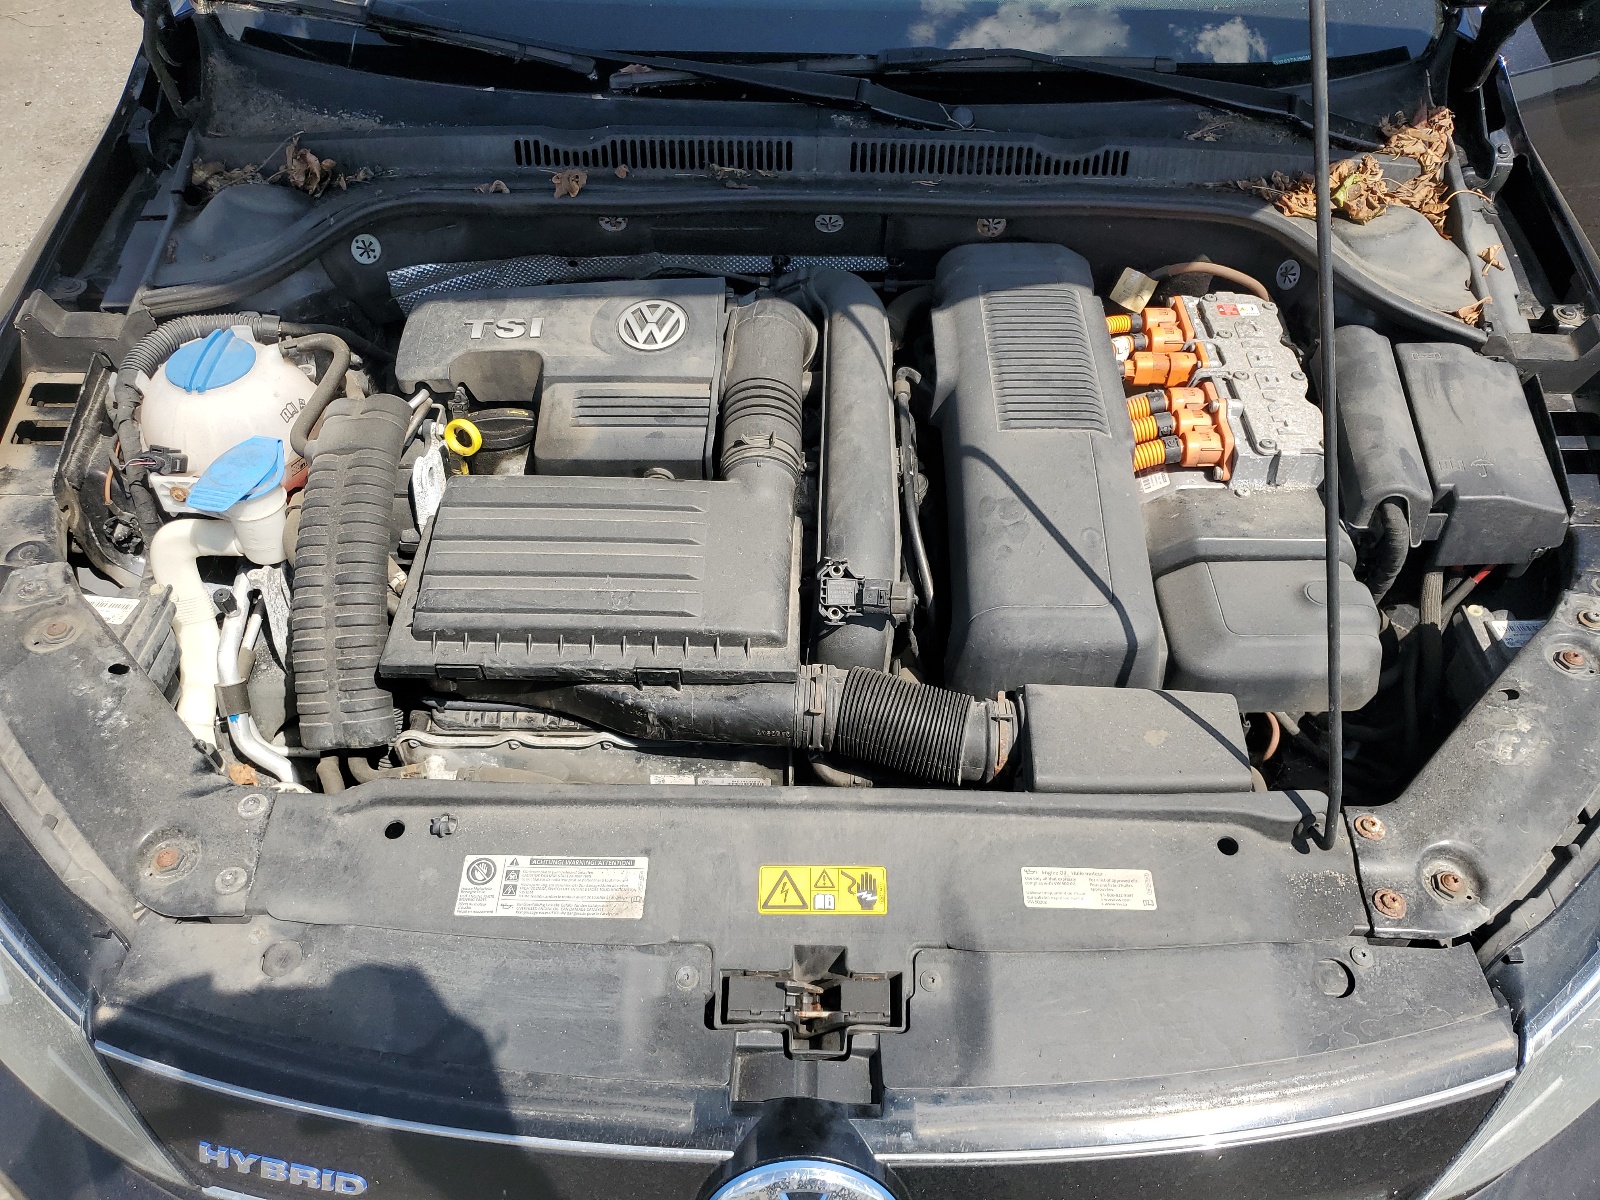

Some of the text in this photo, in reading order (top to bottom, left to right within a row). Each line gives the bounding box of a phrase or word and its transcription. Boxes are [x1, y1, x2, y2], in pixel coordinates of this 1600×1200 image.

[464, 317, 544, 339] TSI
[618, 300, 688, 350] VW
[198, 1140, 368, 1196] HYBRID
